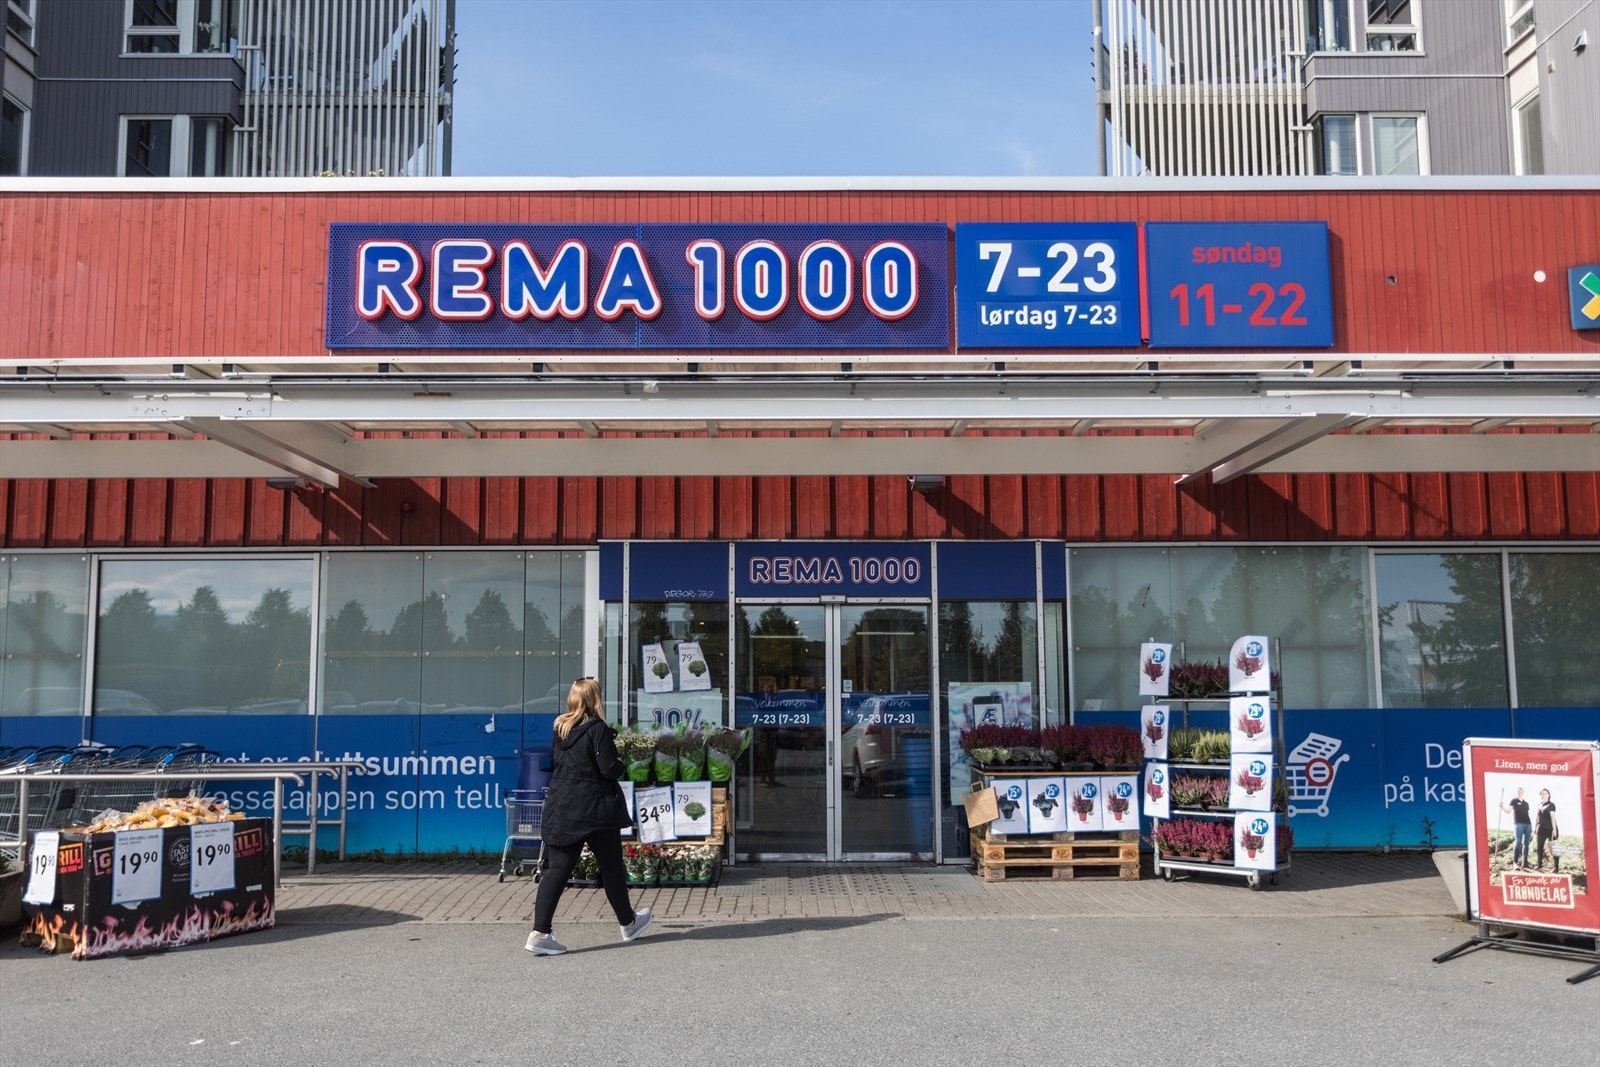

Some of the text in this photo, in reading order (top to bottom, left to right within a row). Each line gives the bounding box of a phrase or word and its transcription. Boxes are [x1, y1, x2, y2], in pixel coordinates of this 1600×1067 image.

[979, 242, 1117, 293] 7-23
[1192, 242, 1281, 269] søndag
[356, 239, 919, 321] REMA 1000
[981, 305, 1117, 330] lørdag 7-23
[1170, 283, 1307, 326] 11-22
[749, 556, 921, 584] REMA 1000
[752, 713, 810, 725] 7-23 (7-23)
[857, 713, 915, 725] 7-23 (7-23)
[1425, 743, 1462, 769] De
[1495, 759, 1569, 772] Liten, men god
[385, 790, 445, 810] som
[454, 782, 516, 810] tell
[1384, 775, 1467, 809] på kas
[59, 848, 81, 866] RILL
[1507, 885, 1567, 902] TRØNDELAG
